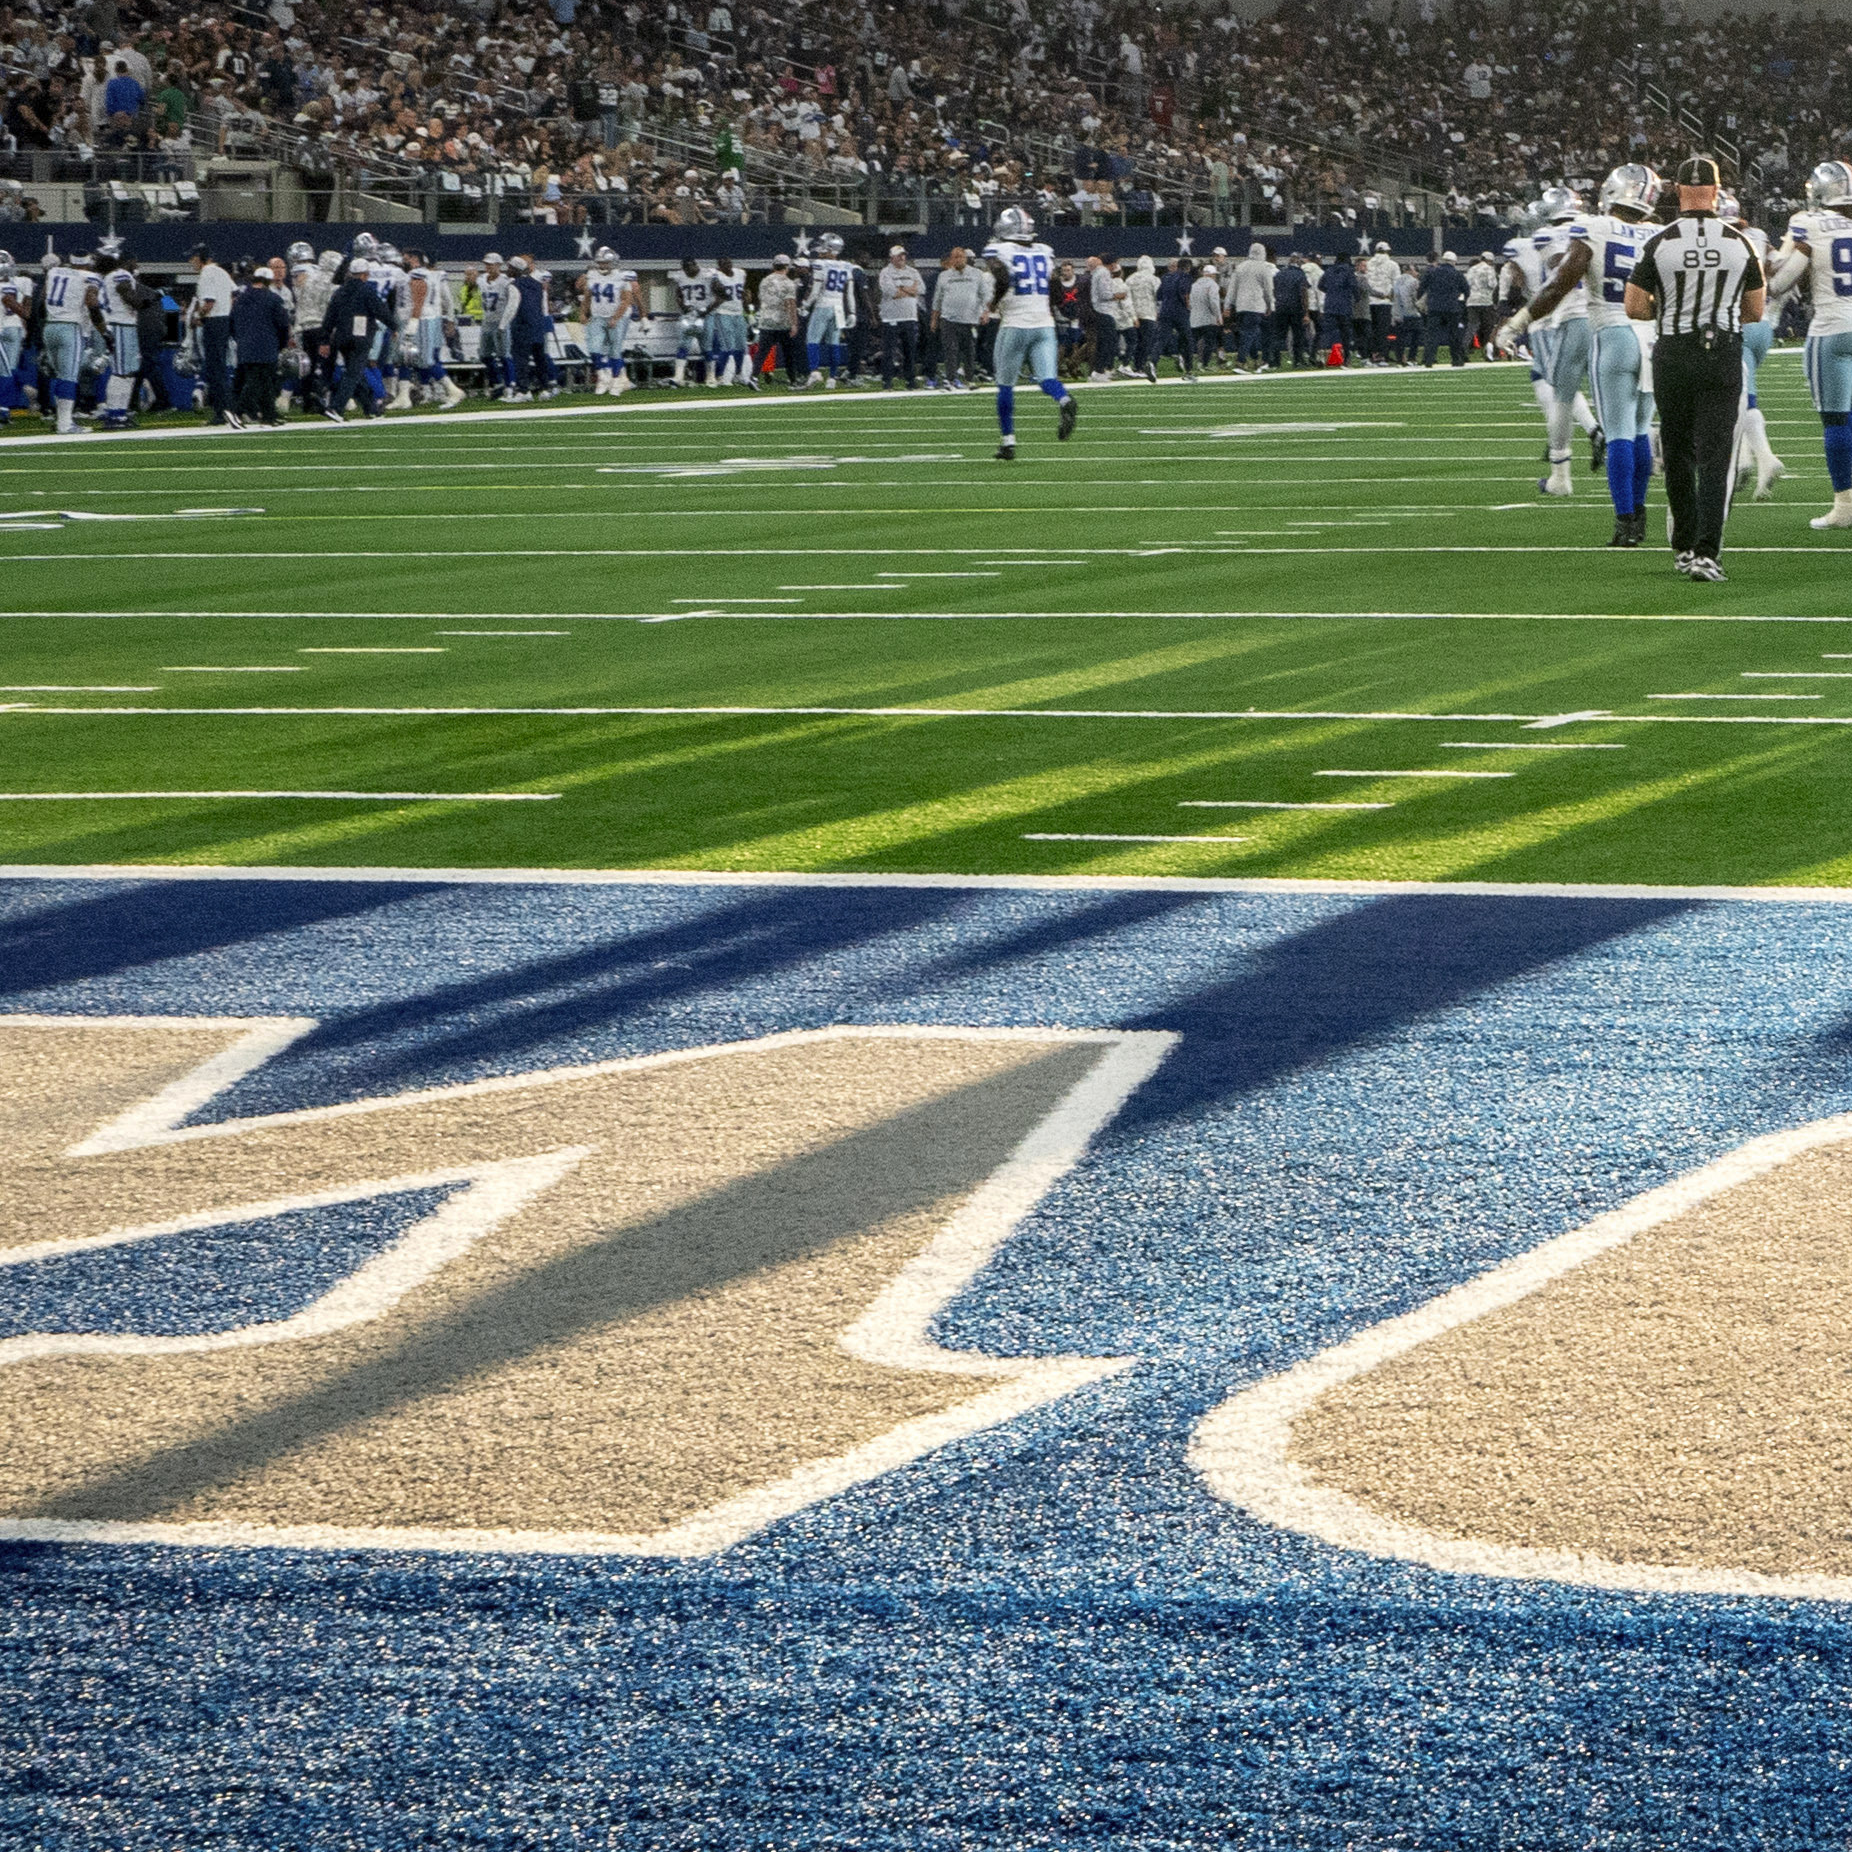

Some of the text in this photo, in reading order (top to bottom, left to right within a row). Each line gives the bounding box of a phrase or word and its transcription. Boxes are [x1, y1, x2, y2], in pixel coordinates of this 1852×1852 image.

[1683, 249, 1721, 269] 89
[826, 269, 848, 293] 89
[1013, 253, 1049, 297] 28
[46, 277, 71, 308] 11
[589, 281, 614, 304] 44
